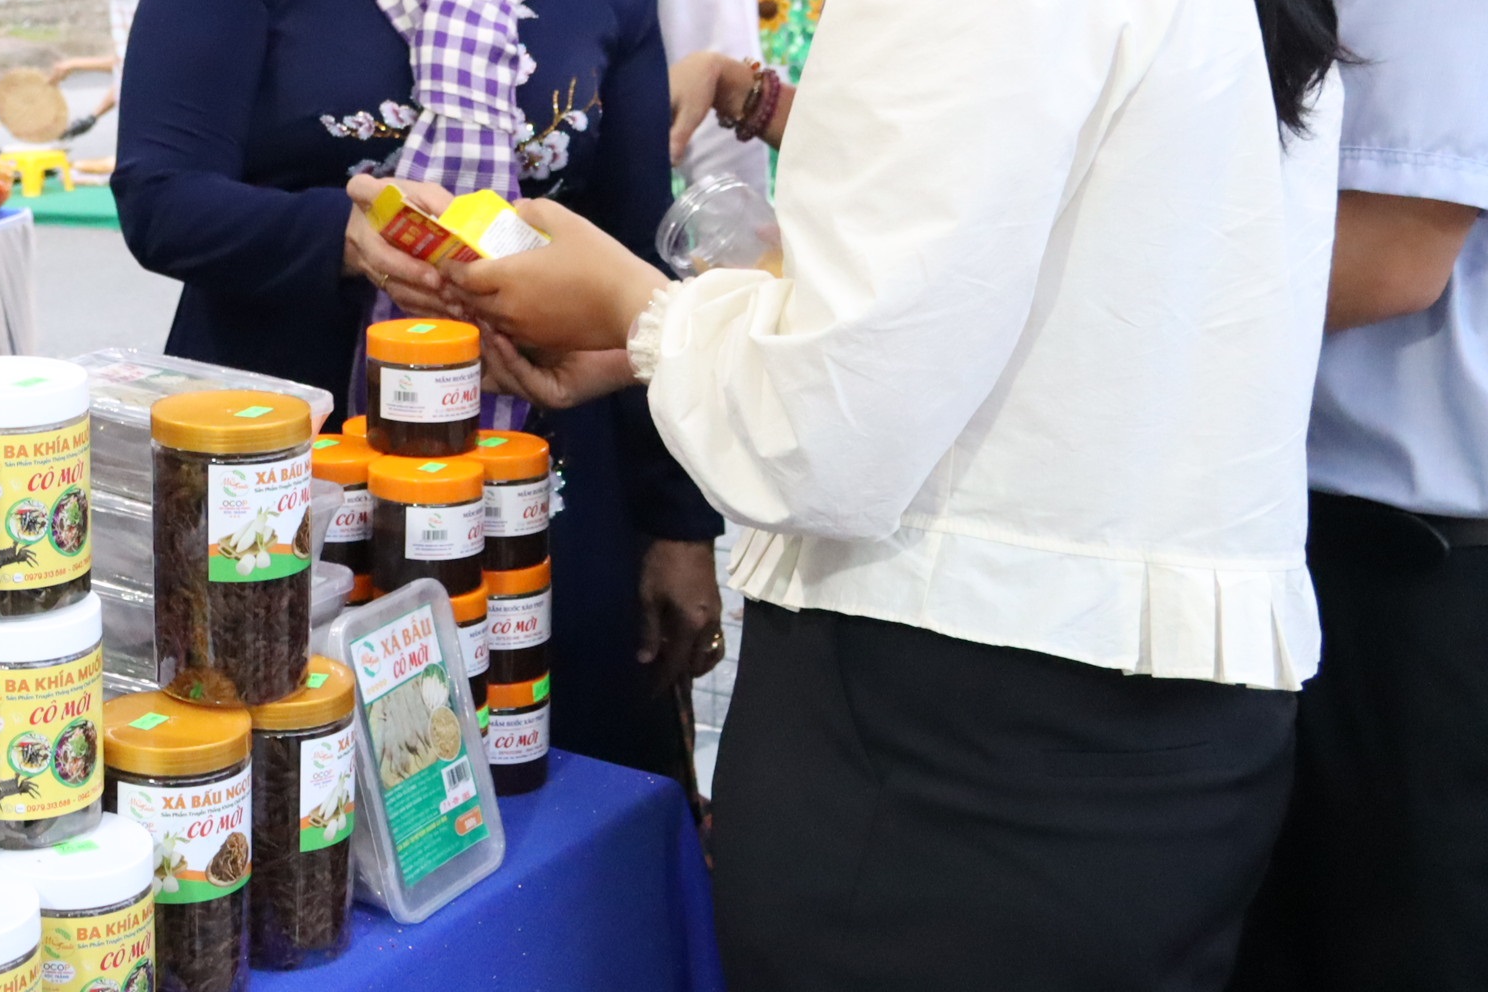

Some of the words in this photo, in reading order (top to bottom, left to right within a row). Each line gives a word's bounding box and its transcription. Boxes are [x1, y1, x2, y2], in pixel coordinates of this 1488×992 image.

[442, 388, 459, 406] CÔ
[4, 445, 29, 459] BA
[34, 435, 70, 457] KHÍA
[28, 466, 55, 492] CÔ
[58, 459, 84, 487] MỚI
[256, 467, 277, 485] XÁ
[281, 462, 302, 481] BẤU
[222, 499, 248, 507] OCOP
[278, 487, 297, 512] CÔ
[335, 510, 354, 527] CÔ
[523, 504, 539, 519] CÔ
[492, 619, 511, 634] CÔ
[513, 616, 538, 633] MỚI
[381, 632, 403, 659] XÁ
[403, 615, 433, 648] BẤU
[393, 653, 409, 679] CÔ
[409, 642, 430, 669] MỚI
[5, 679, 30, 693] BA
[35, 670, 74, 691] KHÍA
[29, 700, 57, 725] CÔ
[61, 691, 91, 720] MỚI
[338, 732, 351, 752] XÁ
[495, 733, 514, 749] CÔ
[516, 730, 539, 748] MỚI
[162, 793, 186, 809] XÁ
[192, 789, 221, 809] BẤU
[187, 815, 213, 839] CÔ
[216, 805, 243, 834] MỚI
[77, 927, 101, 941] BA
[106, 913, 140, 937] KHÍA
[43, 963, 70, 971] OCOP
[100, 943, 126, 971] CÔ
